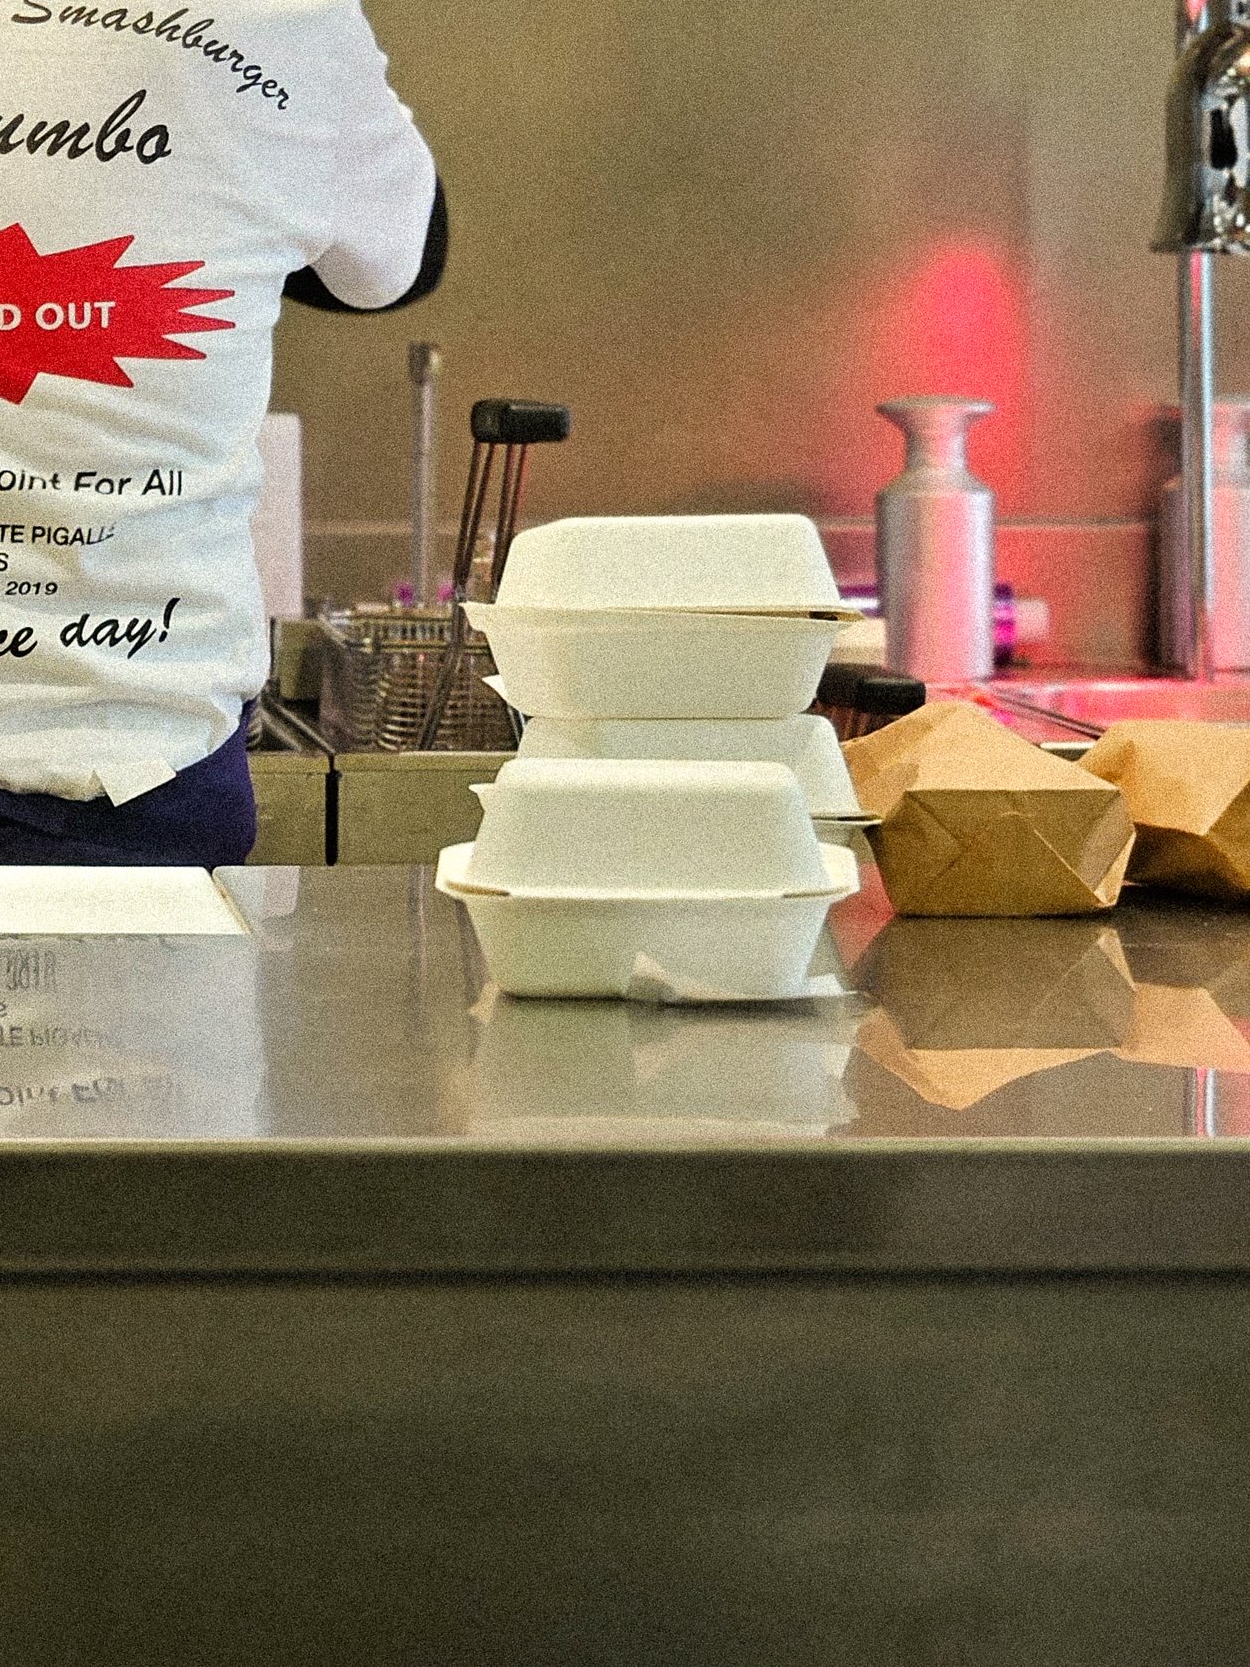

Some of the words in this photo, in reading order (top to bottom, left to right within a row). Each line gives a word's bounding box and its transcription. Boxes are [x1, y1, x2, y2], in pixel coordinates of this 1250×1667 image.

[35, 300, 116, 331] OUT
[74, 471, 132, 495] For
[141, 469, 183, 497] All
[5, 580, 59, 596] 2019
[60, 597, 181, 658] day!
